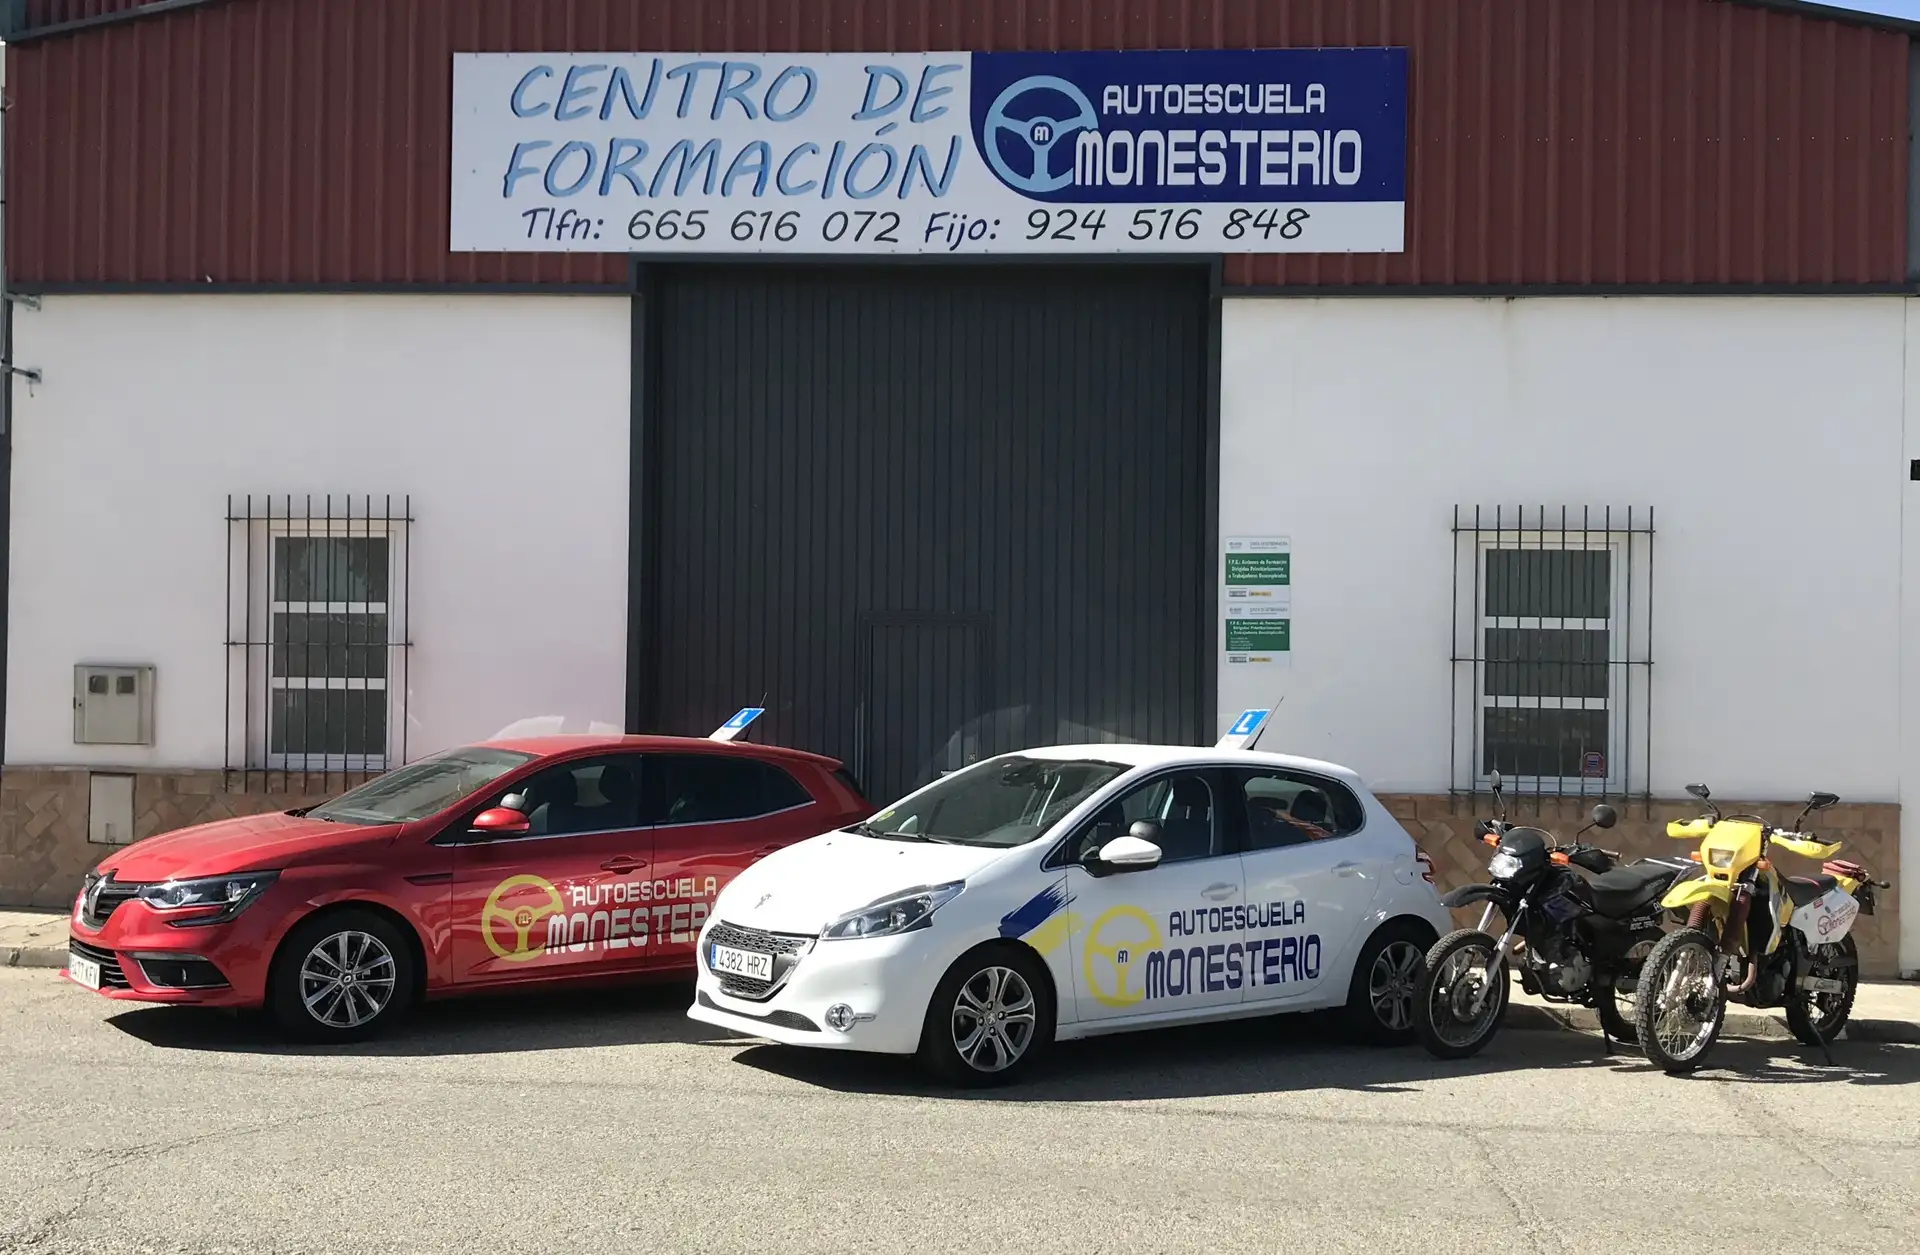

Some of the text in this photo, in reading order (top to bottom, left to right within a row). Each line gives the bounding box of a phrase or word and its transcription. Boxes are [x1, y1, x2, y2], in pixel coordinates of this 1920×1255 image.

[510, 58, 964, 122] CENTRO DE
[1103, 83, 1326, 115] AUTOESCUELA
[503, 122, 963, 199] FORMACIÓN
[1075, 129, 1362, 186] MONESTERIO
[522, 207, 1311, 251] Tlfn: 665 616 072 Fijo: 924 516 848
[730, 711, 749, 726] L
[1235, 713, 1253, 732] L
[572, 876, 717, 907] AUTOESCUELA
[1169, 900, 1305, 937] AUTOESCUELA
[719, 949, 768, 977] 4382 HRZ
[1145, 933, 1322, 1000] MONESTERIO
